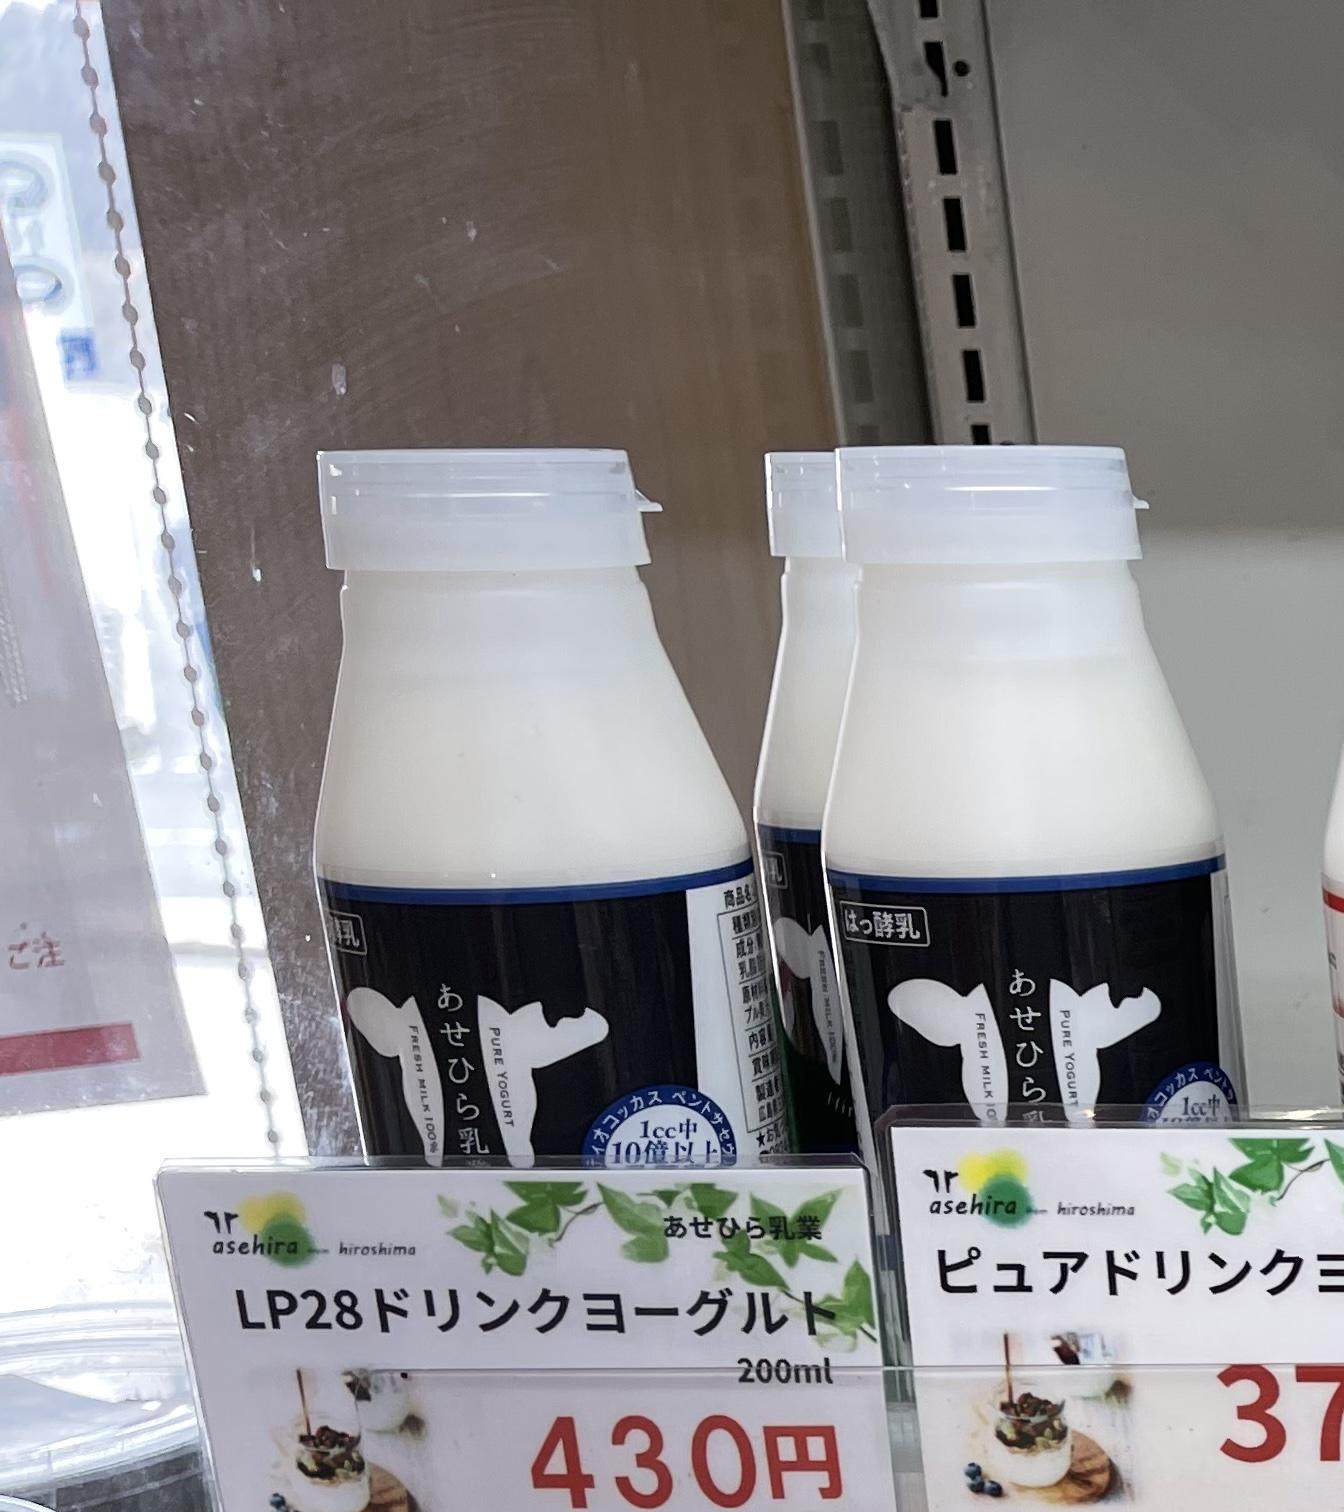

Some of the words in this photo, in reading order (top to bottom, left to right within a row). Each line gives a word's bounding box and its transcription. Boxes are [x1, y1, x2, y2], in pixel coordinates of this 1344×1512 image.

[845, 908, 922, 941] はっ酵乳
[975, 1012, 989, 1062] FRESH
[1060, 1010, 1072, 1049] PURE
[437, 983, 489, 1166] あせひら乳
[930, 1193, 1017, 1215] asehira
[1057, 1202, 1135, 1216] hiroshima
[213, 1234, 298, 1255] asehira
[339, 1242, 416, 1256] hiroshima
[664, 1214, 823, 1241] あせひら乳業
[235, 1287, 837, 1337] LP28ドリンクヨーグルト
[737, 1357, 834, 1386] 200ml
[530, 1414, 844, 1509] 430円
